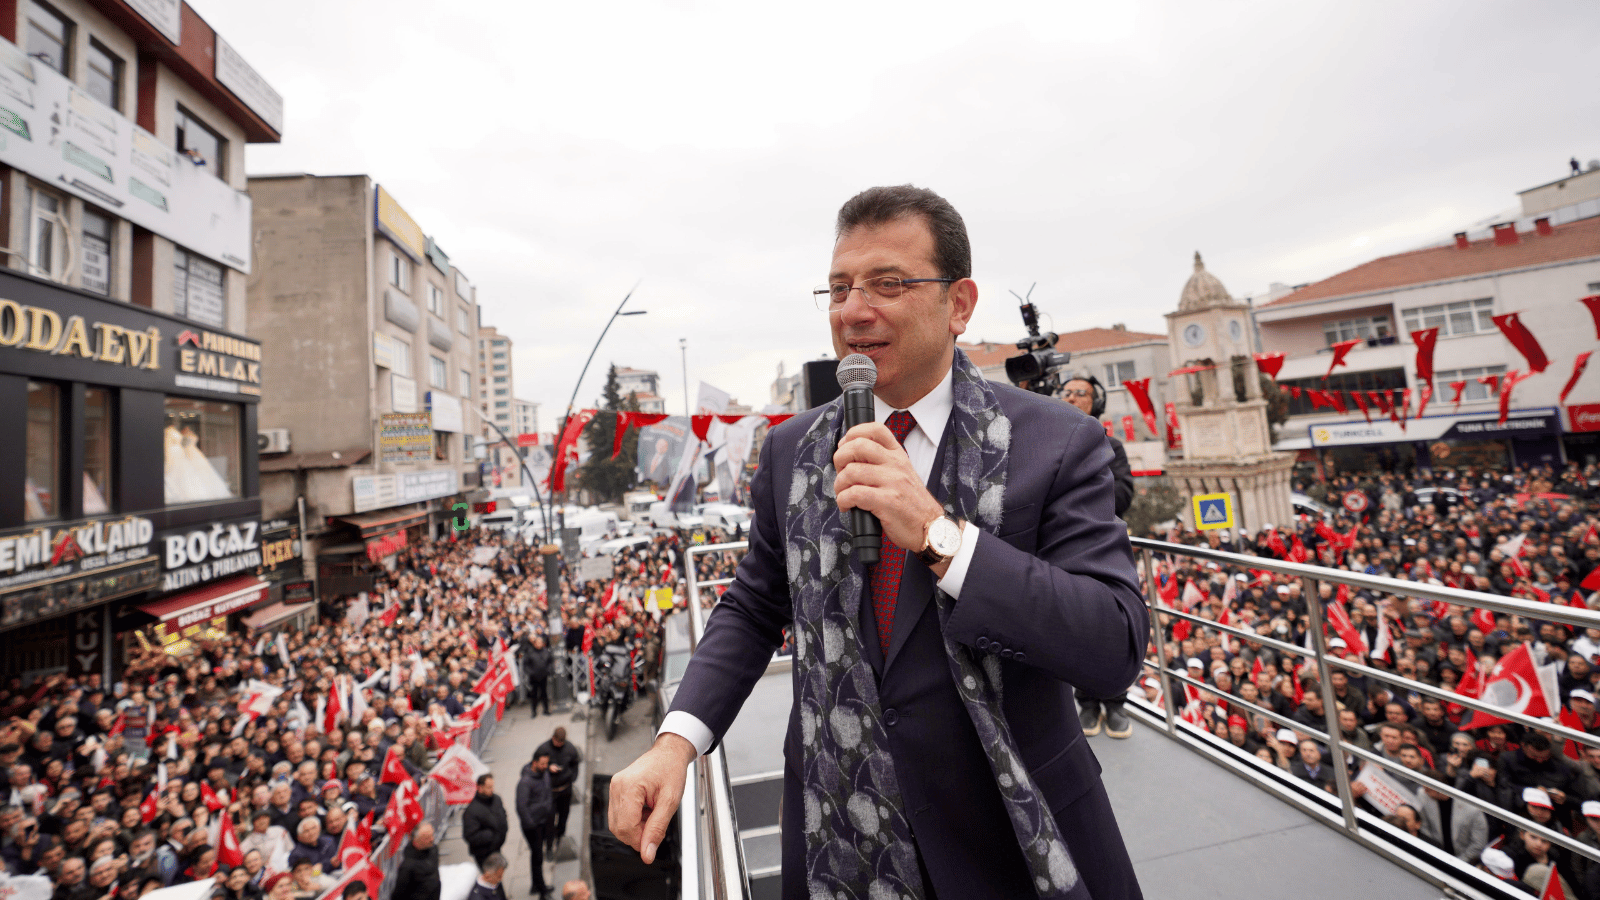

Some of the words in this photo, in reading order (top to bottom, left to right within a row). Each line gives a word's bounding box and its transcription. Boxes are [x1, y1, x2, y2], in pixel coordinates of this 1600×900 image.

[181, 349, 260, 384] EMLAK
[0, 516, 153, 572] EMLAKLAND
[165, 521, 259, 569] BOĞAZ
[259, 539, 294, 573] İÇEK
[163, 566, 200, 592] ALTIN
[201, 563, 211, 581] &
[212, 551, 262, 578] PIRLANTA
